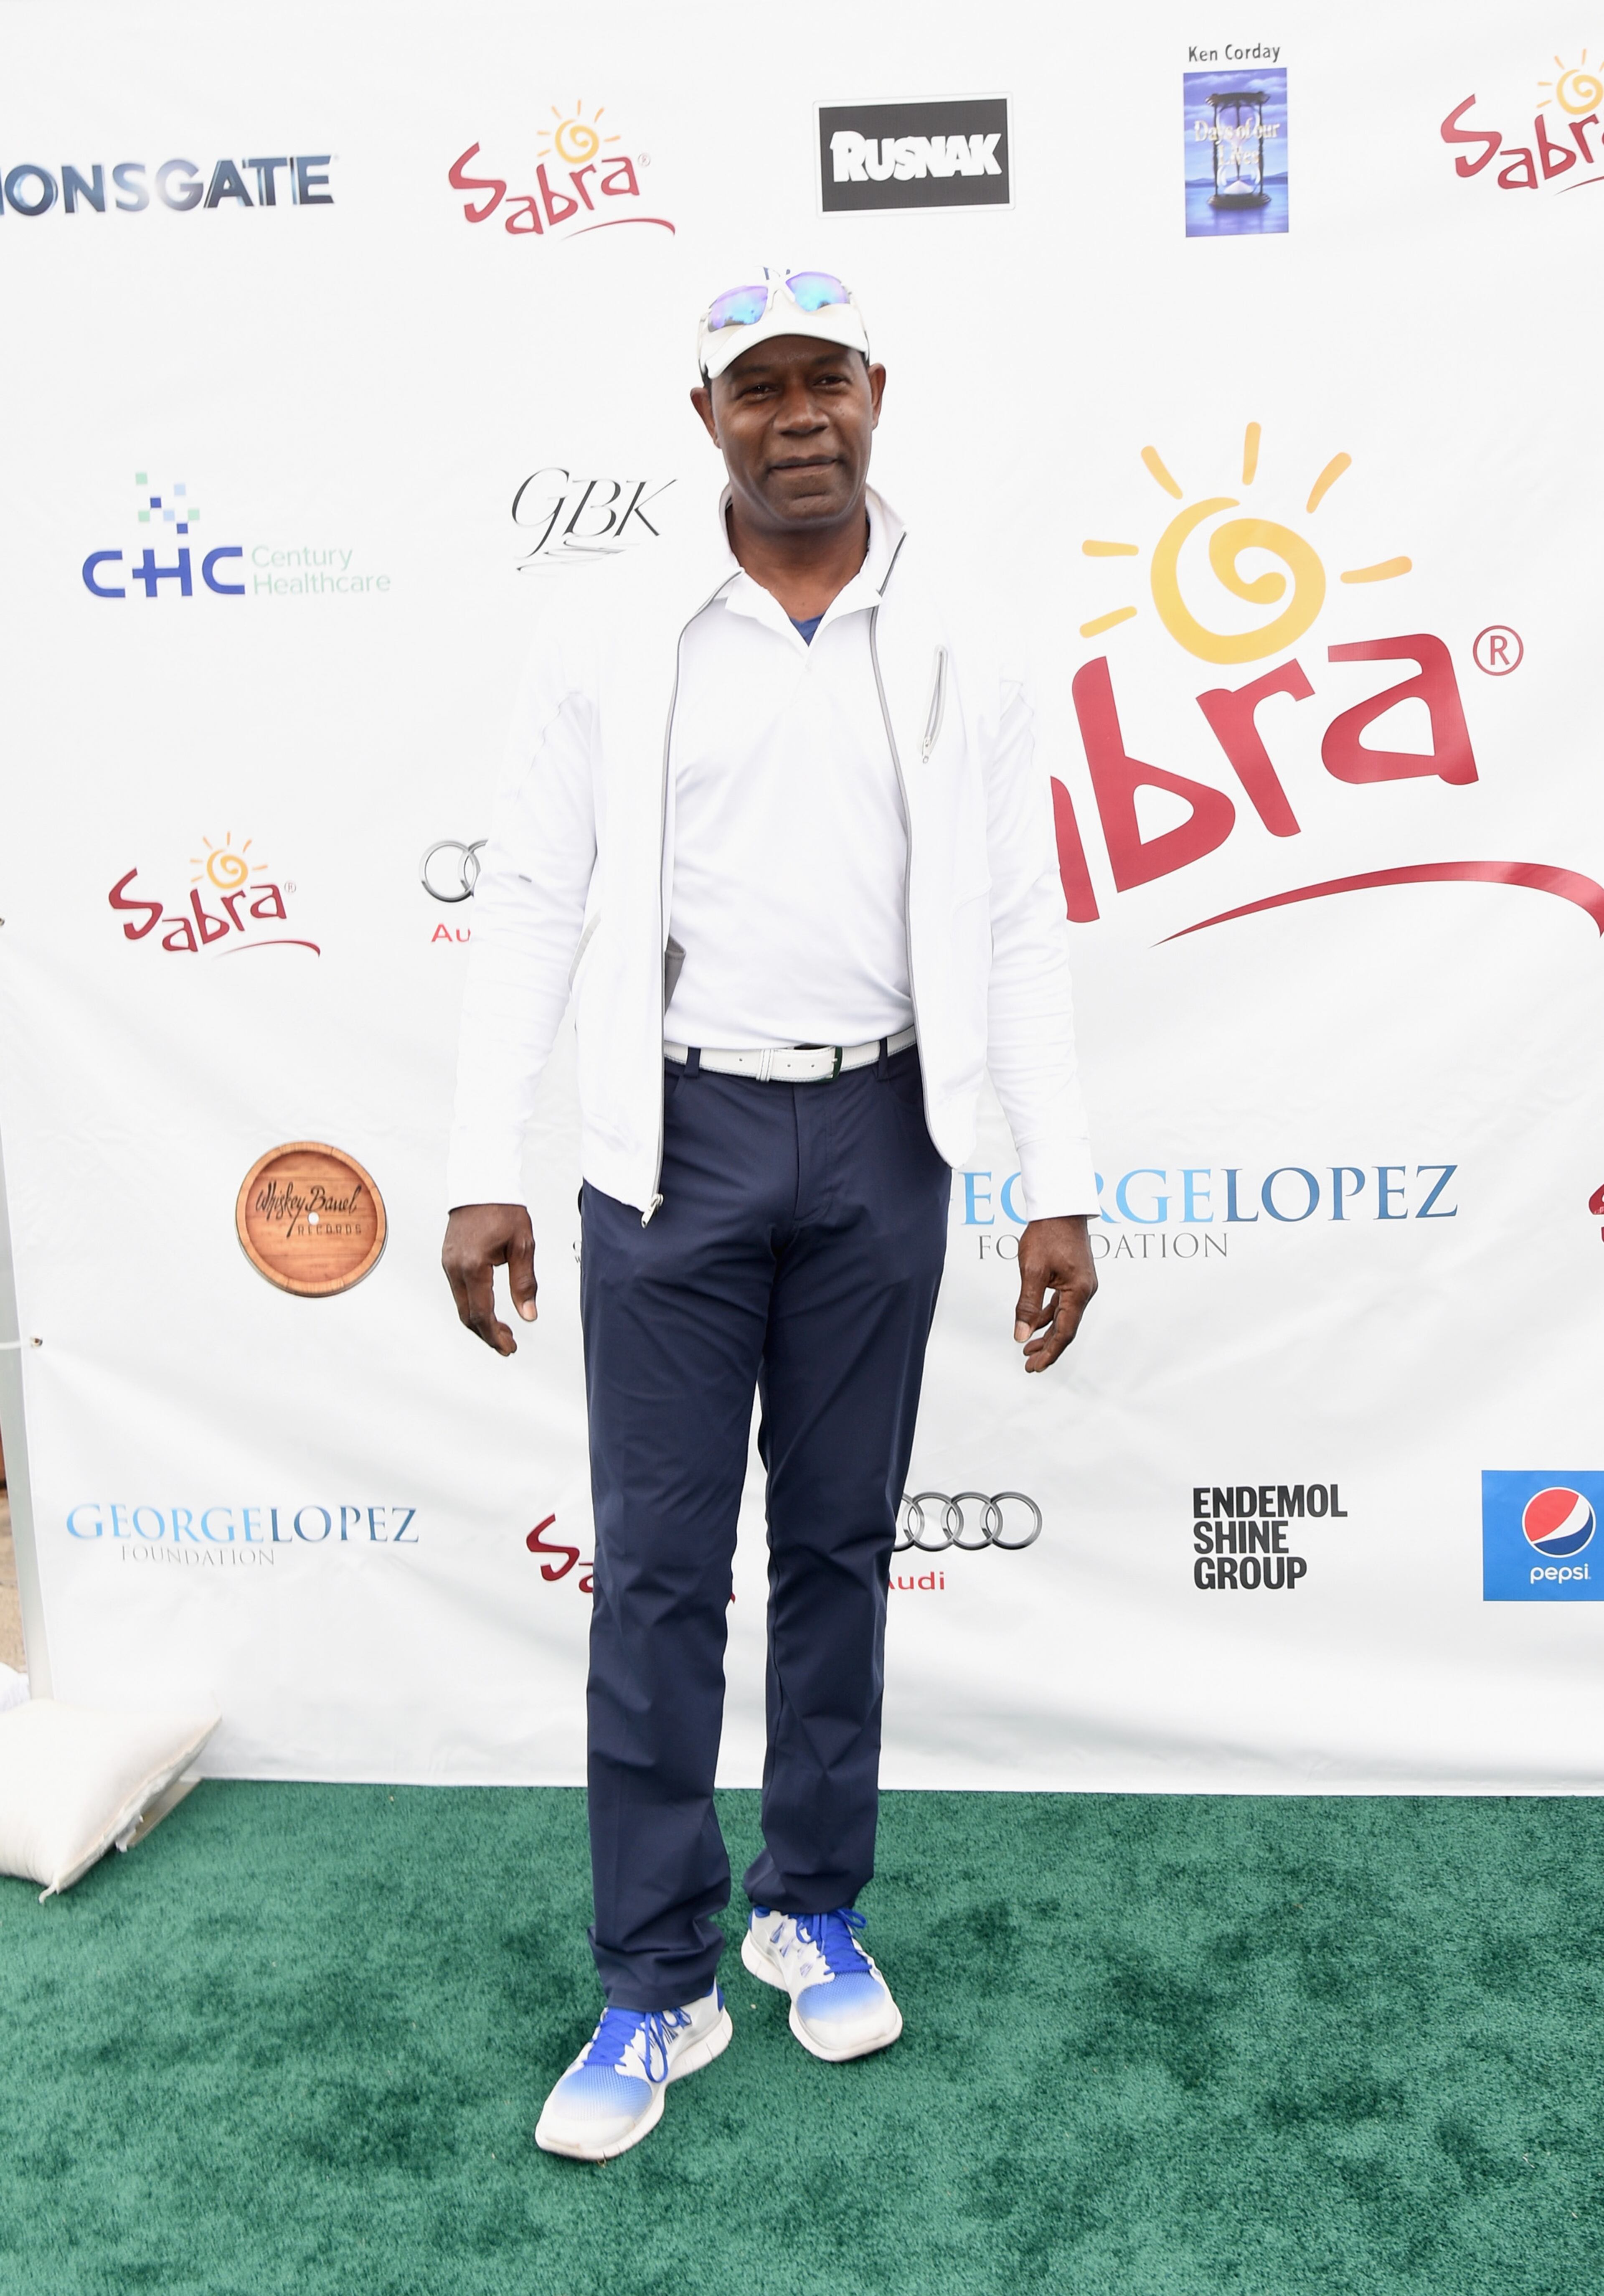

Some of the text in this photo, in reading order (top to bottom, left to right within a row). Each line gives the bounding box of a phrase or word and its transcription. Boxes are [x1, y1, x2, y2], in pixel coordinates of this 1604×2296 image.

[1188, 43, 1280, 63] Ken Corday
[1194, 117, 1280, 145] Days of our
[1440, 93, 1604, 190] Sabr
[829, 130, 1002, 182] RUSNAK
[448, 141, 640, 234] Sabra
[511, 467, 678, 559] GBK
[82, 546, 246, 598] CHC
[251, 544, 353, 570] Century
[253, 571, 391, 595] Healthcare
[1050, 633, 1479, 924] bra
[108, 867, 287, 952] Sabra
[431, 923, 471, 942] Au
[256, 1180, 306, 1239] Whiskey
[297, 1224, 362, 1236] RECORDS
[979, 1232, 1228, 1260] FODATION
[1193, 1484, 1348, 1519] ENDEMOL
[1193, 1521, 1289, 1554] SHINE
[122, 1544, 275, 1566] FOUNDATION
[1194, 1556, 1307, 1590] GROUP
[1530, 1563, 1589, 1584] pepsi
